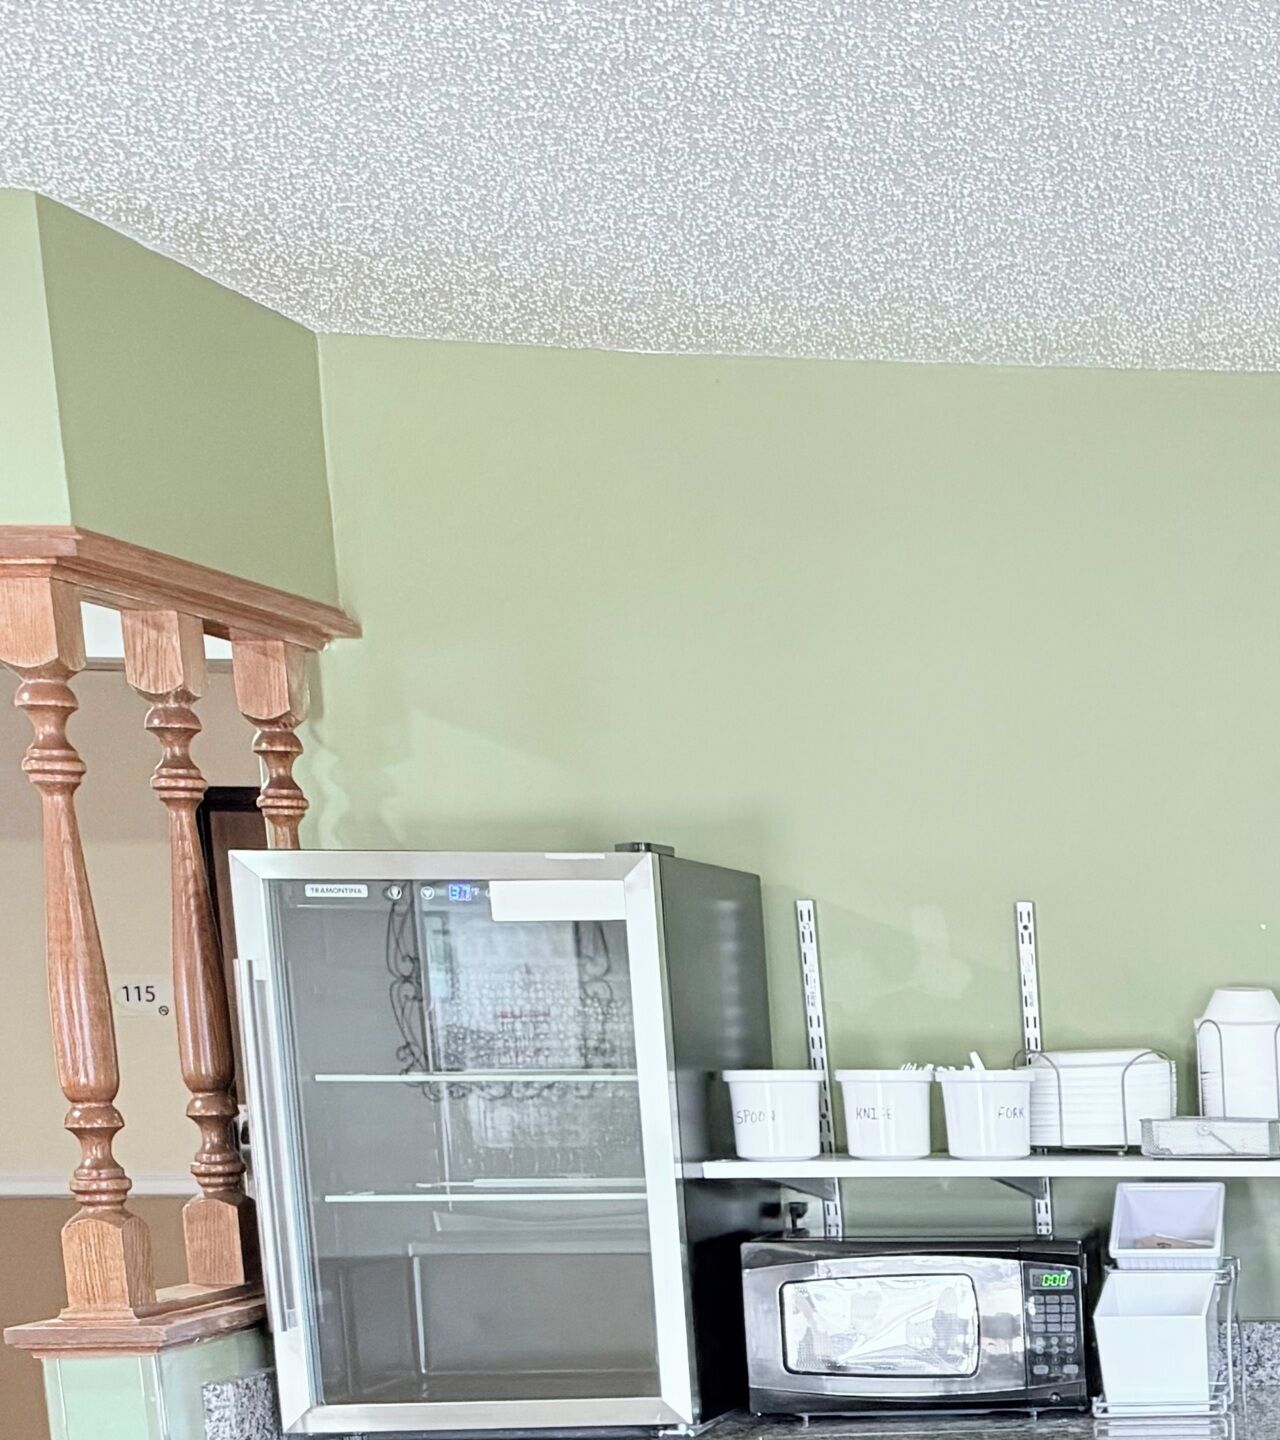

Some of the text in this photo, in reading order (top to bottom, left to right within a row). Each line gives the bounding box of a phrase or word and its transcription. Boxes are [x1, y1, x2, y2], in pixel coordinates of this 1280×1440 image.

[310, 886, 363, 896] TRAMONTINA
[122, 985, 156, 1003] 115
[998, 1106, 1026, 1120] FORK
